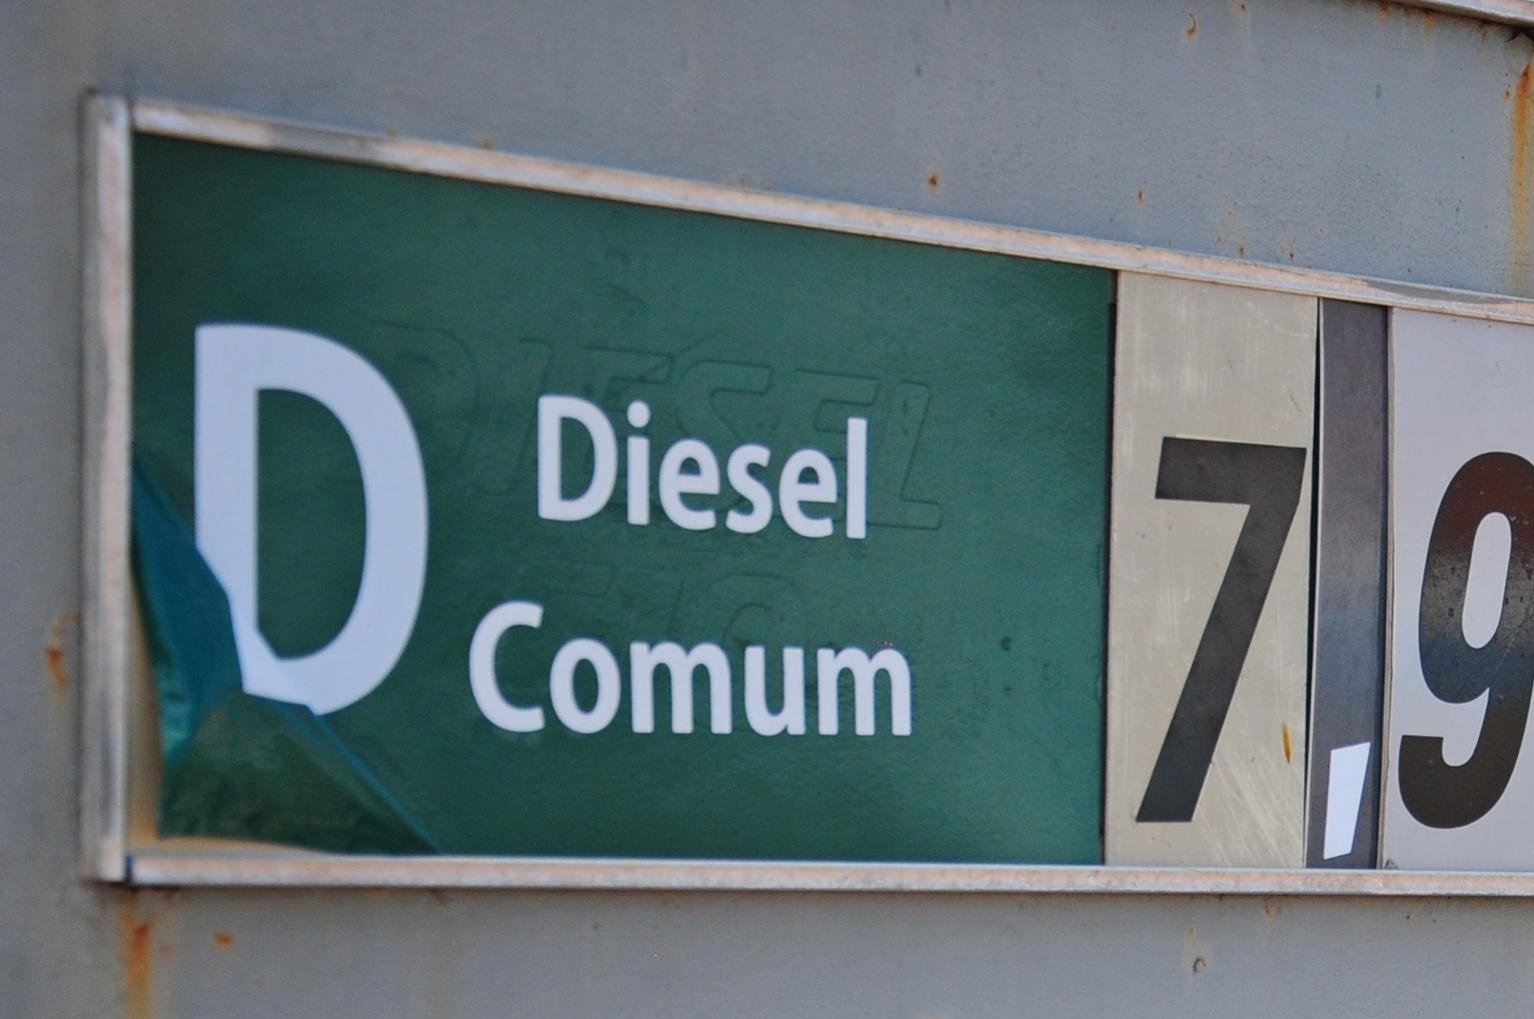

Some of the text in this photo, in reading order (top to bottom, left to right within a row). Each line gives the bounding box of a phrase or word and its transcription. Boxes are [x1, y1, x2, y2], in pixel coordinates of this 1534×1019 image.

[194, 322, 429, 716] D
[537, 394, 867, 539] Diesel
[468, 600, 912, 738] Comum
